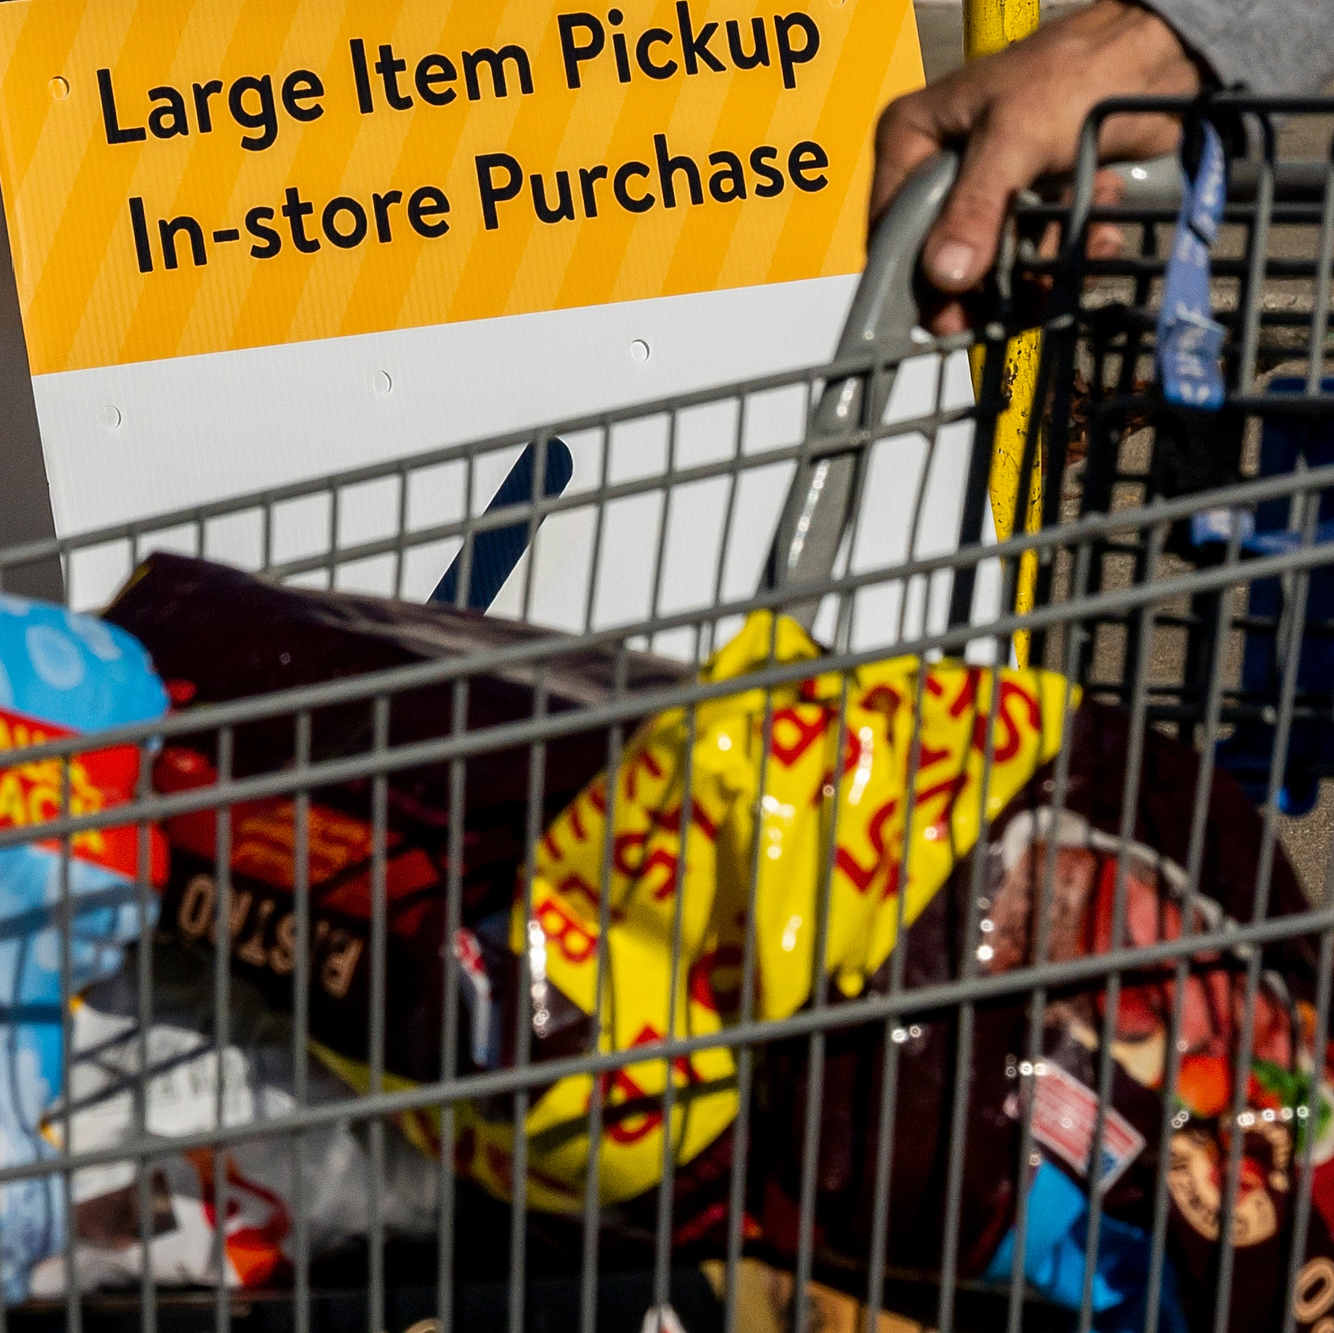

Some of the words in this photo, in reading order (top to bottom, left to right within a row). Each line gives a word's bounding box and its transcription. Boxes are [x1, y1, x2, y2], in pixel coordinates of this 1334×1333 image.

[97, 69, 324, 151] Large
[350, 38, 533, 113] Item
[558, 1, 819, 89] Pickup
[129, 186, 449, 272] In-store
[475, 134, 828, 230] Purchase
